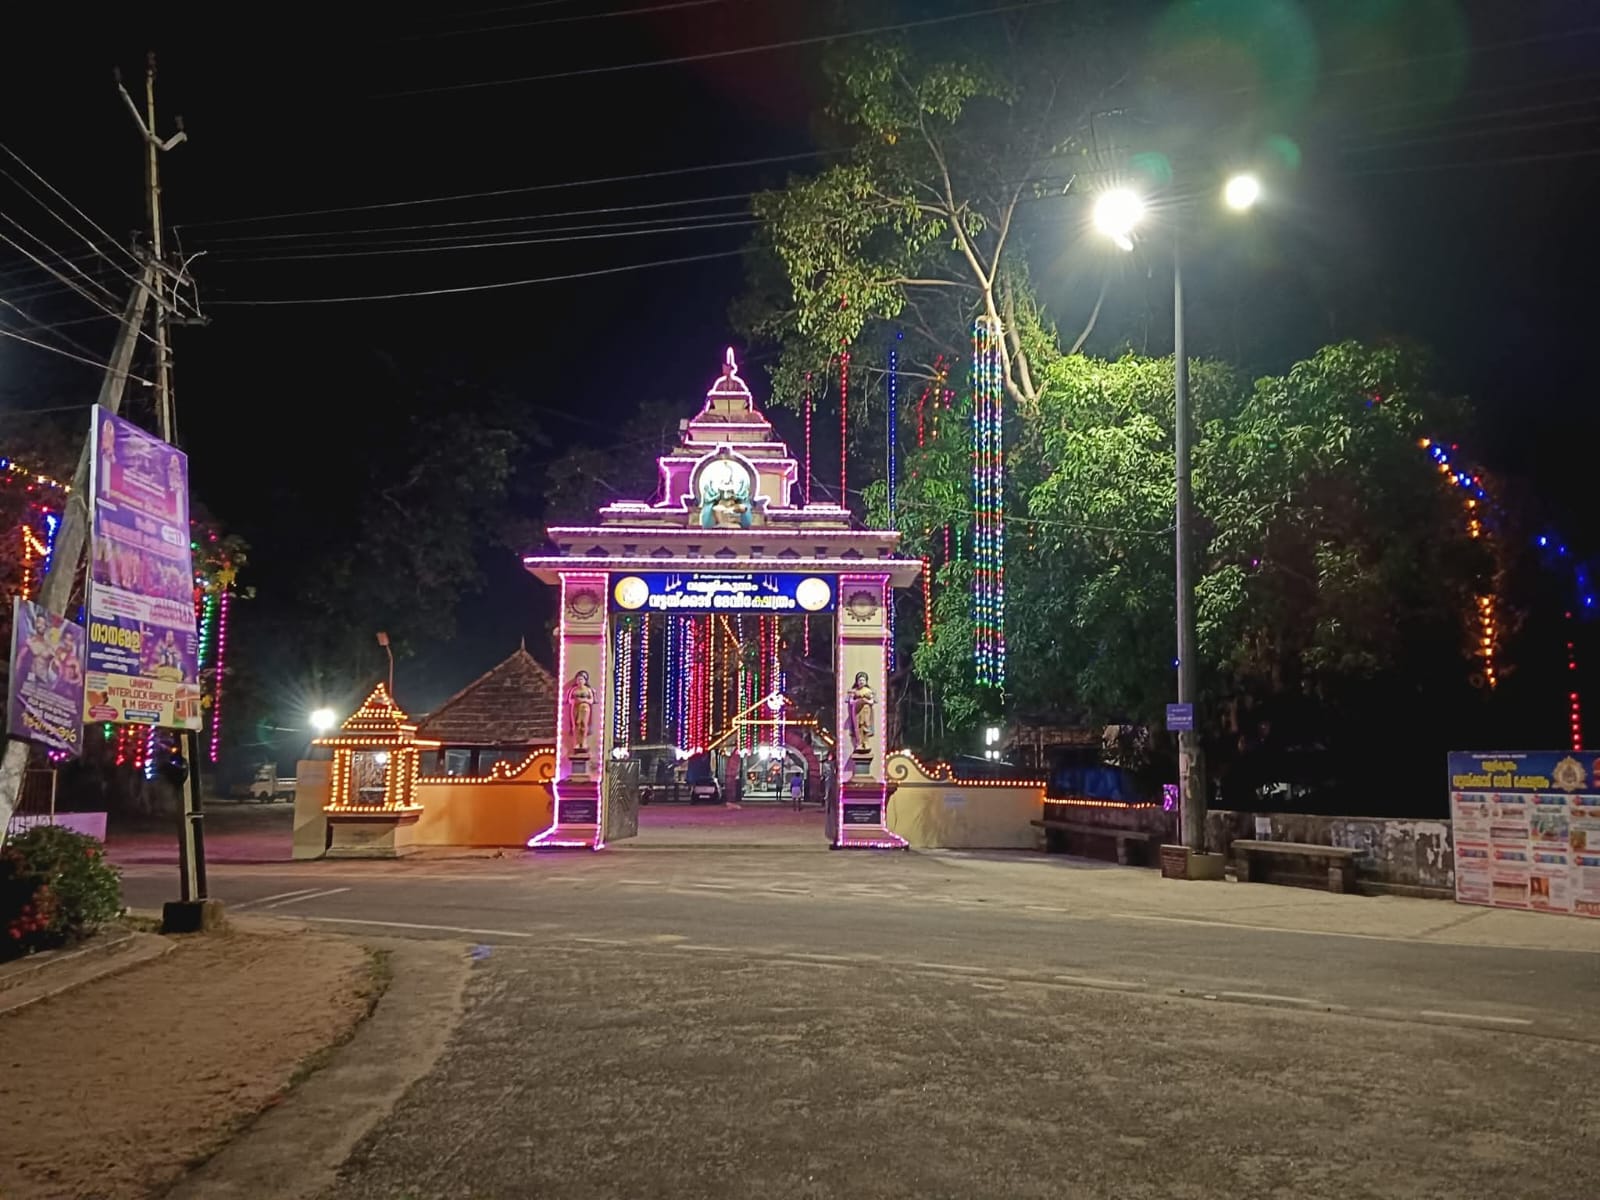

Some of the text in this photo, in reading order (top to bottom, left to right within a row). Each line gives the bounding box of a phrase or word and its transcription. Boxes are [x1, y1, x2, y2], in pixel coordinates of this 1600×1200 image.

[90, 622, 141, 653] ഗാനമേള
[108, 686, 174, 703] INTERLOCK BRICKS
[138, 701, 164, 711] BRICKS
